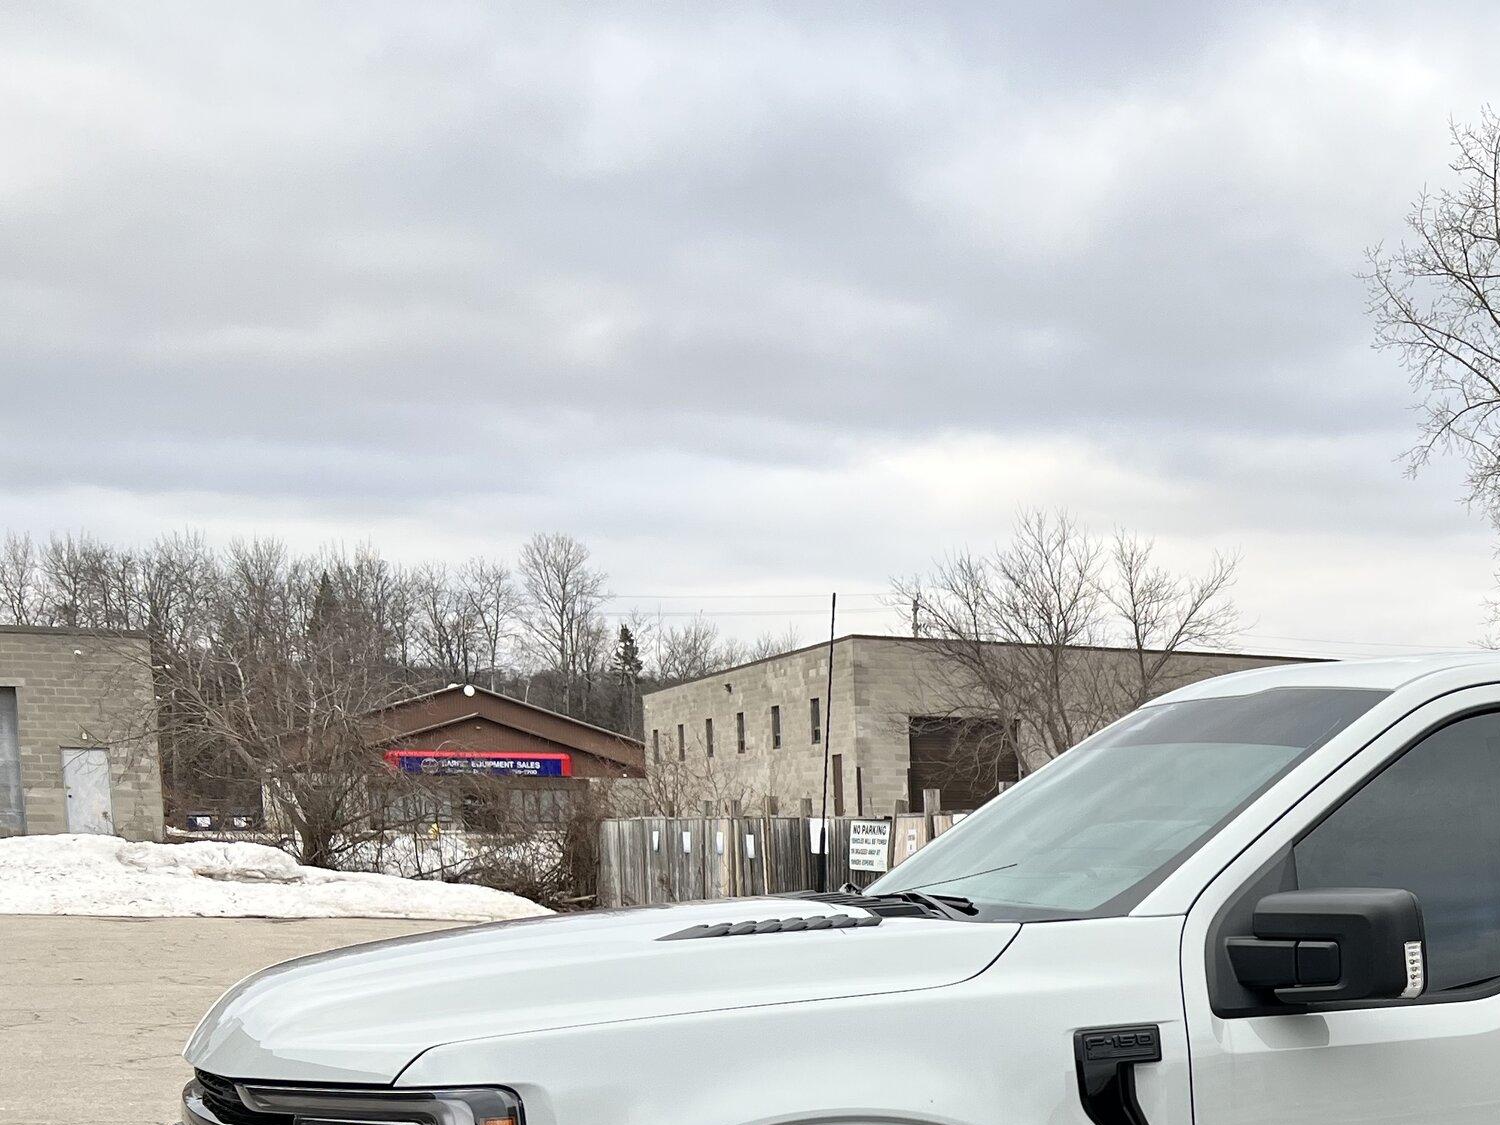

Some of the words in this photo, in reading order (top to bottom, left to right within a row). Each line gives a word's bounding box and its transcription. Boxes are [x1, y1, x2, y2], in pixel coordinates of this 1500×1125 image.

[516, 761, 540, 770] SALES
[853, 825, 861, 835] NO
[862, 825, 887, 835] PARKING
[1085, 1032, 1154, 1050] F-150
